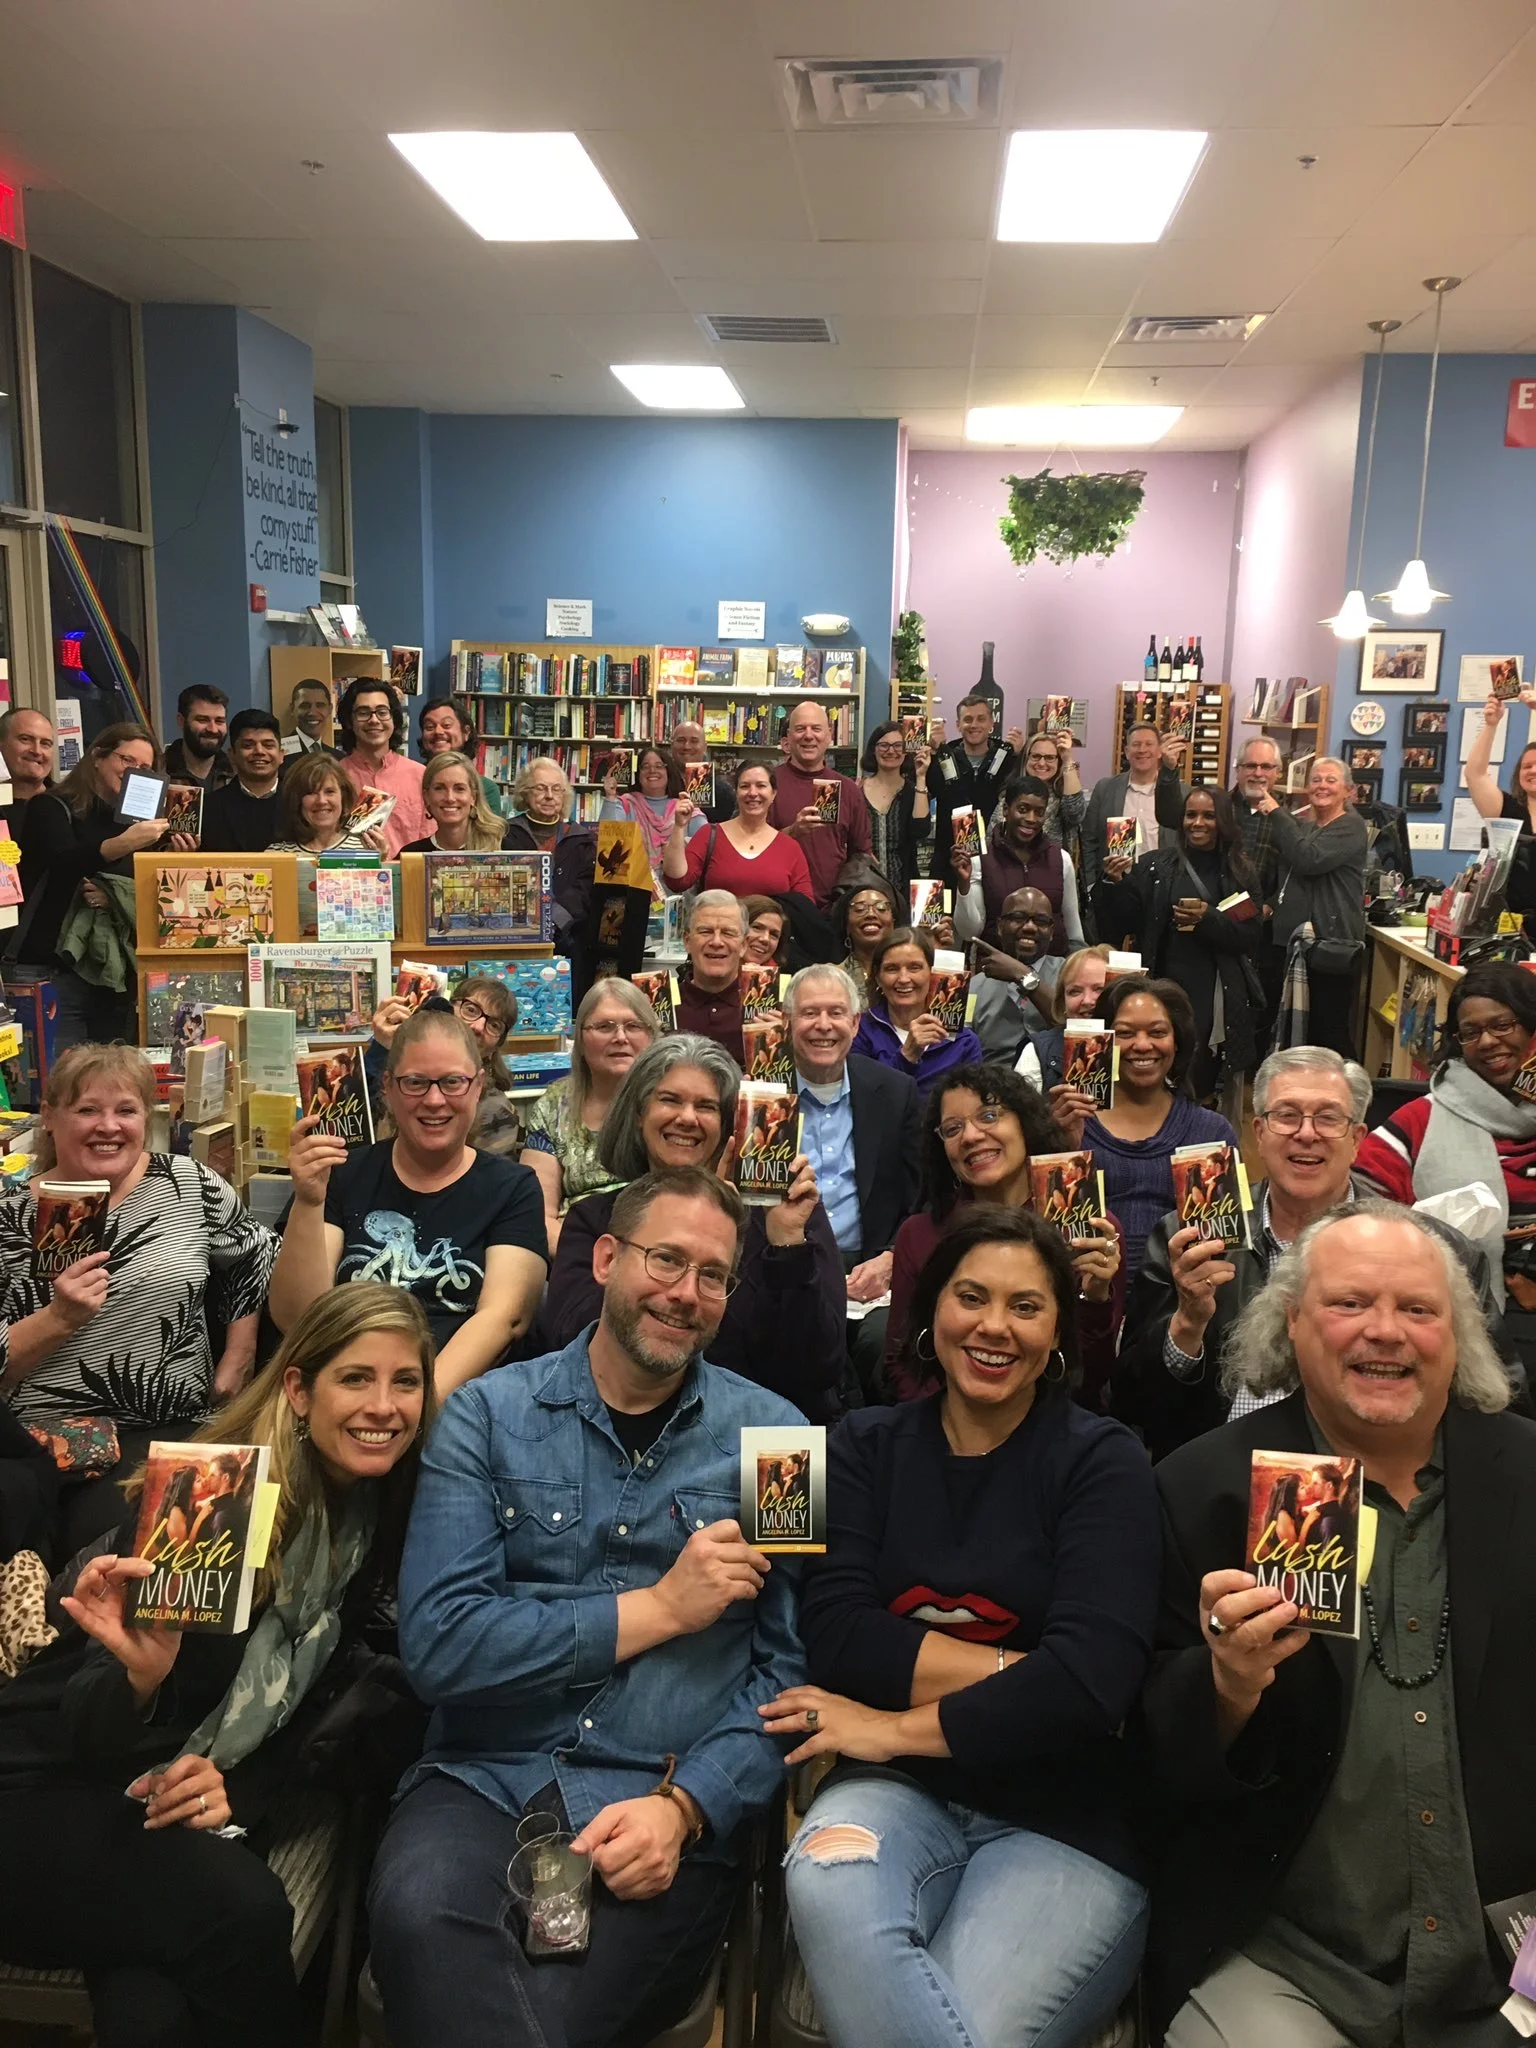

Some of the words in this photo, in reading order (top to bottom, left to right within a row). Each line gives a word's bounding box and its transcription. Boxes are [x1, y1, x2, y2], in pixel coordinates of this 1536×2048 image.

[266, 438, 285, 471] the
[246, 467, 260, 499] be
[260, 471, 286, 510] kind,
[286, 480, 297, 509] all
[297, 482, 318, 513] that
[289, 546, 318, 577] Fisher
[542, 856, 551, 894] 1000
[267, 945, 332, 957] Ravensburger
[343, 946, 373, 955] Puzzle
[250, 958, 262, 983] 1000
[526, 1072, 540, 1080] LIFE
[1065, 1066, 1111, 1085] Lush
[307, 1093, 364, 1121] Lush
[312, 1114, 363, 1137] MONEY
[739, 1133, 796, 1163] Lush
[740, 1159, 792, 1182] MONEY
[1182, 1193, 1239, 1223] Lush
[37, 1228, 100, 1256] Lush
[760, 1486, 809, 1513] Lush
[762, 1509, 807, 1529] MONEY
[140, 1518, 243, 1574] Lush
[1253, 1520, 1355, 1573] Lush
[138, 1567, 233, 1609] MONEY
[1256, 1564, 1347, 1610] MONEY
[135, 1607, 179, 1620] ANGELINA
[181, 1610, 192, 1621] M.
[193, 1611, 223, 1623] LOPEZ
[1300, 1608, 1310, 1619] M.
[1312, 1609, 1341, 1623] LOPEZ
